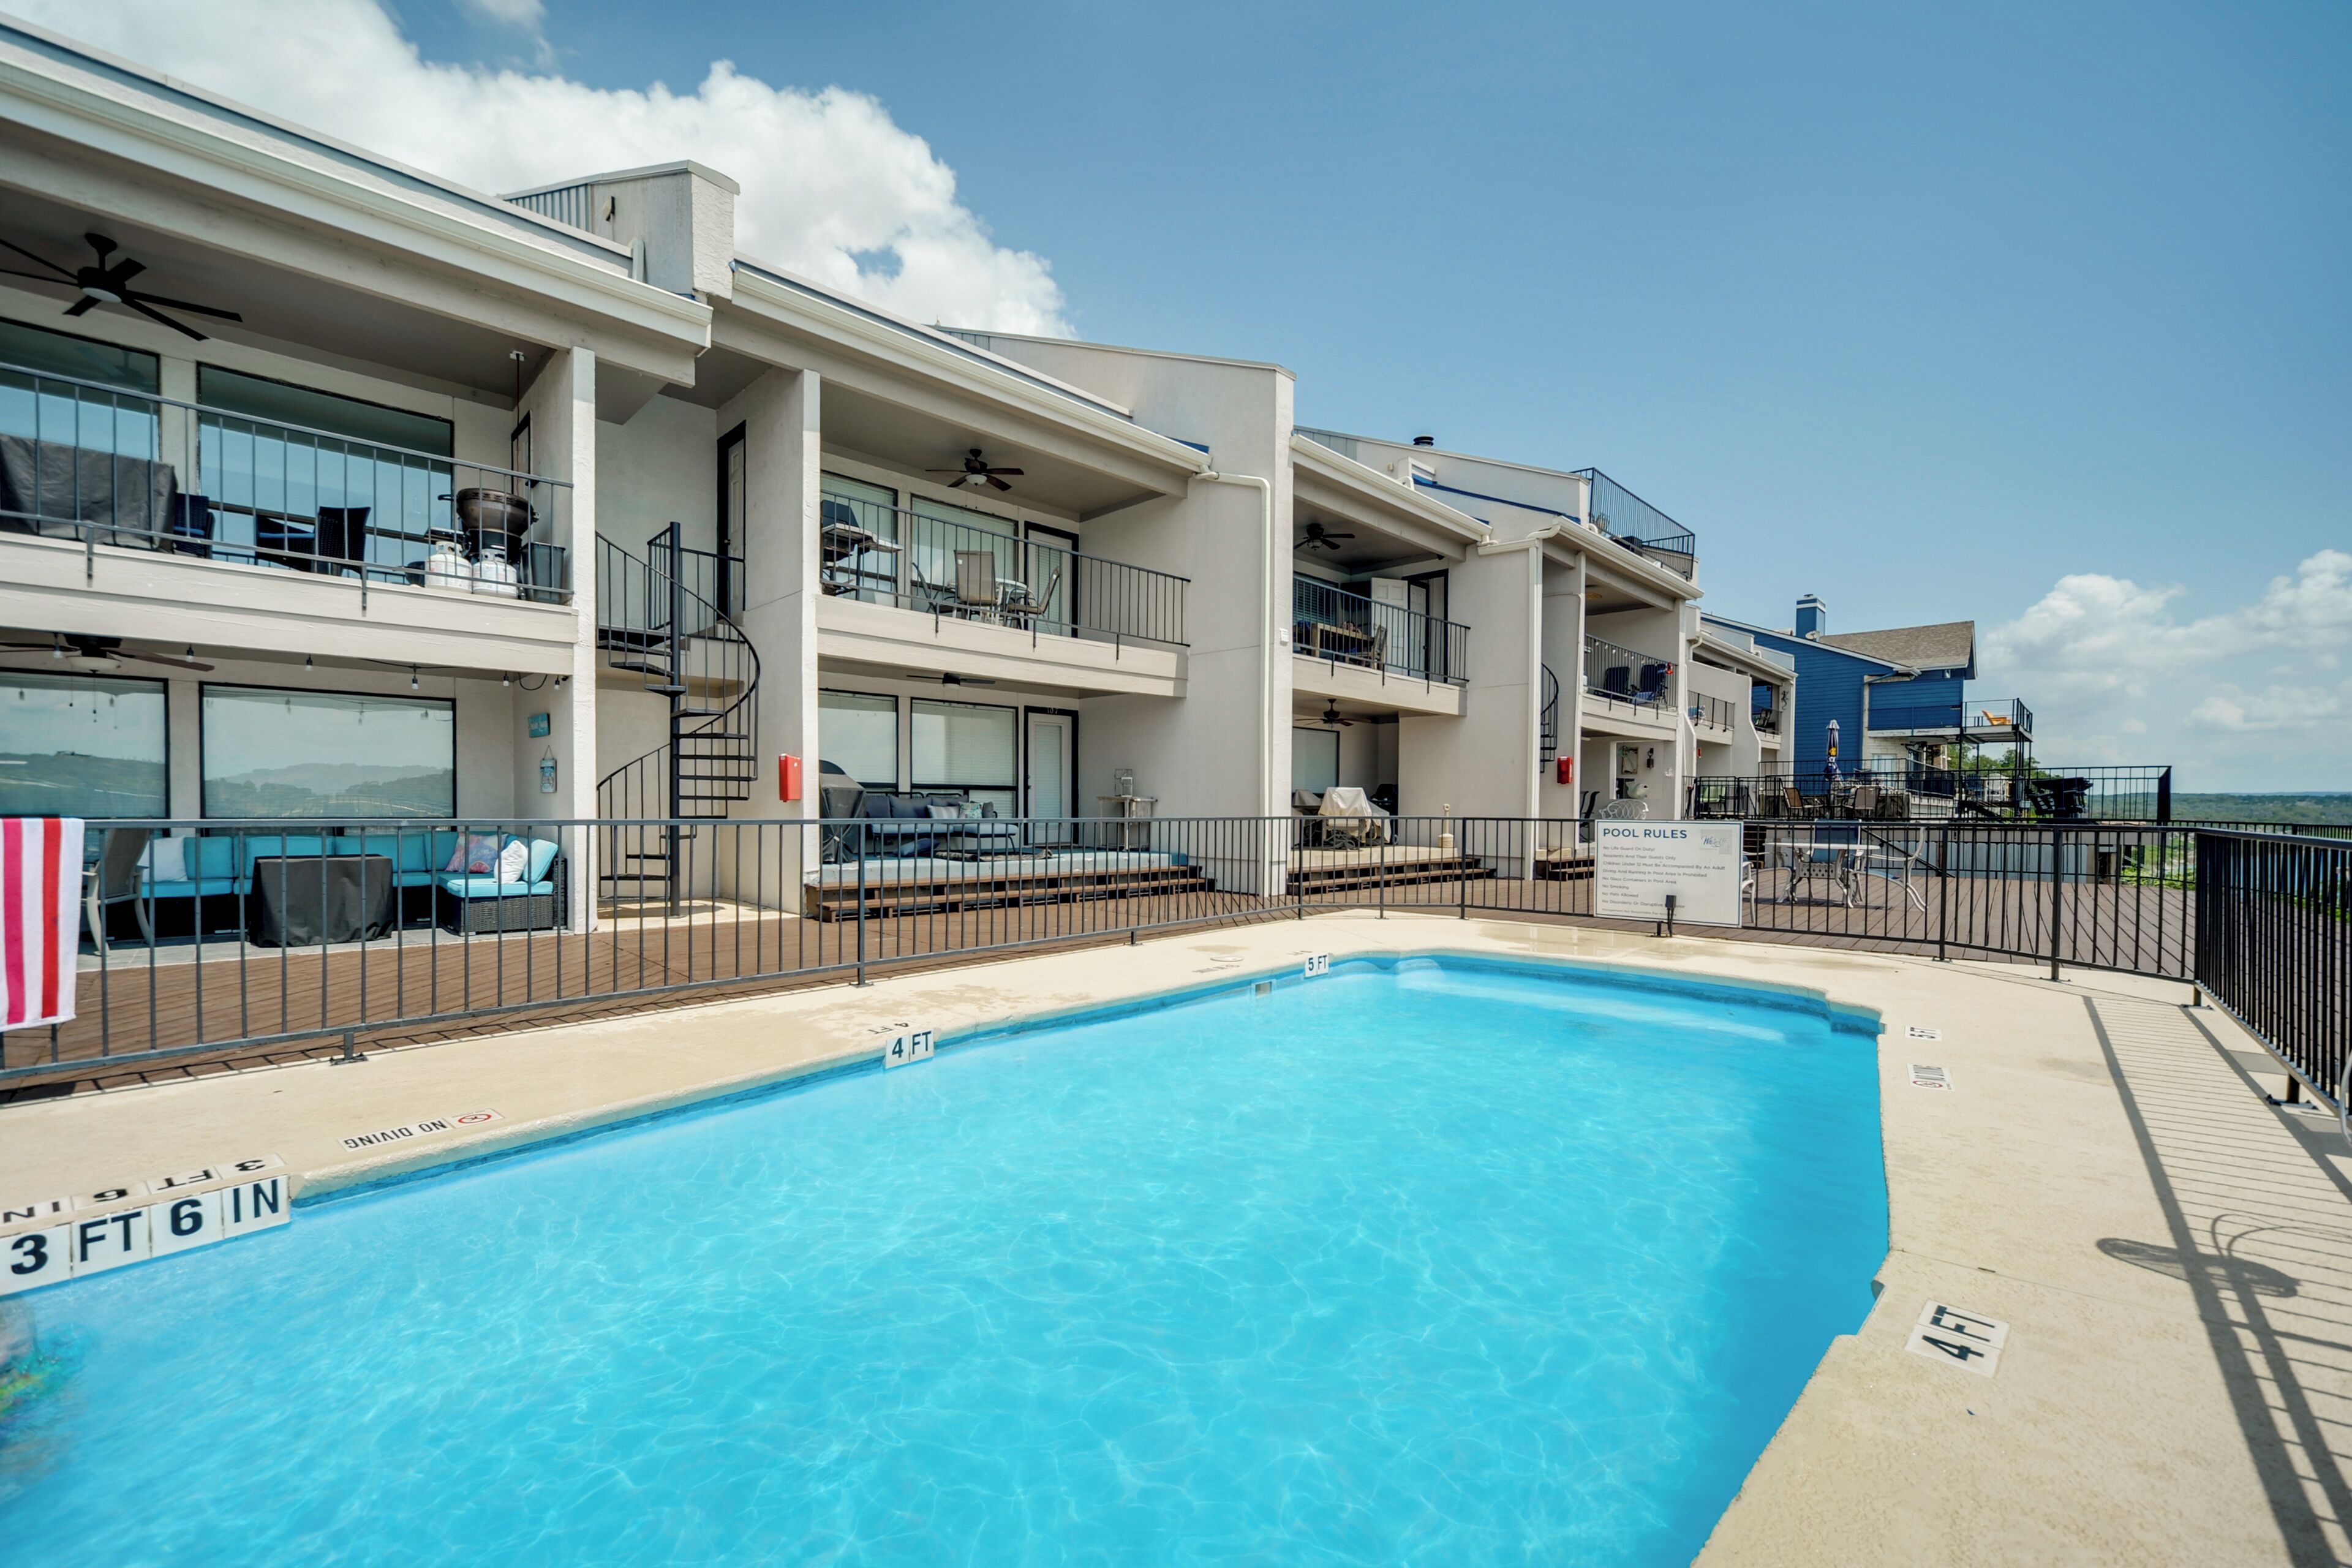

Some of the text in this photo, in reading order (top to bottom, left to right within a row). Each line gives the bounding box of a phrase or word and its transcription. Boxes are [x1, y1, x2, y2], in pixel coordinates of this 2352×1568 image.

[1603, 828, 1687, 839] POOL RULES
[1308, 954, 1327, 971] 5 FT
[891, 1030, 932, 1058] 4 FT
[344, 1120, 448, 1149] NO DIVING
[3, 1159, 266, 1223] 3 FT 6 IN
[10, 1179, 280, 1275] 3 FT 6 IN
[1921, 1305, 1996, 1361] 4 FT
